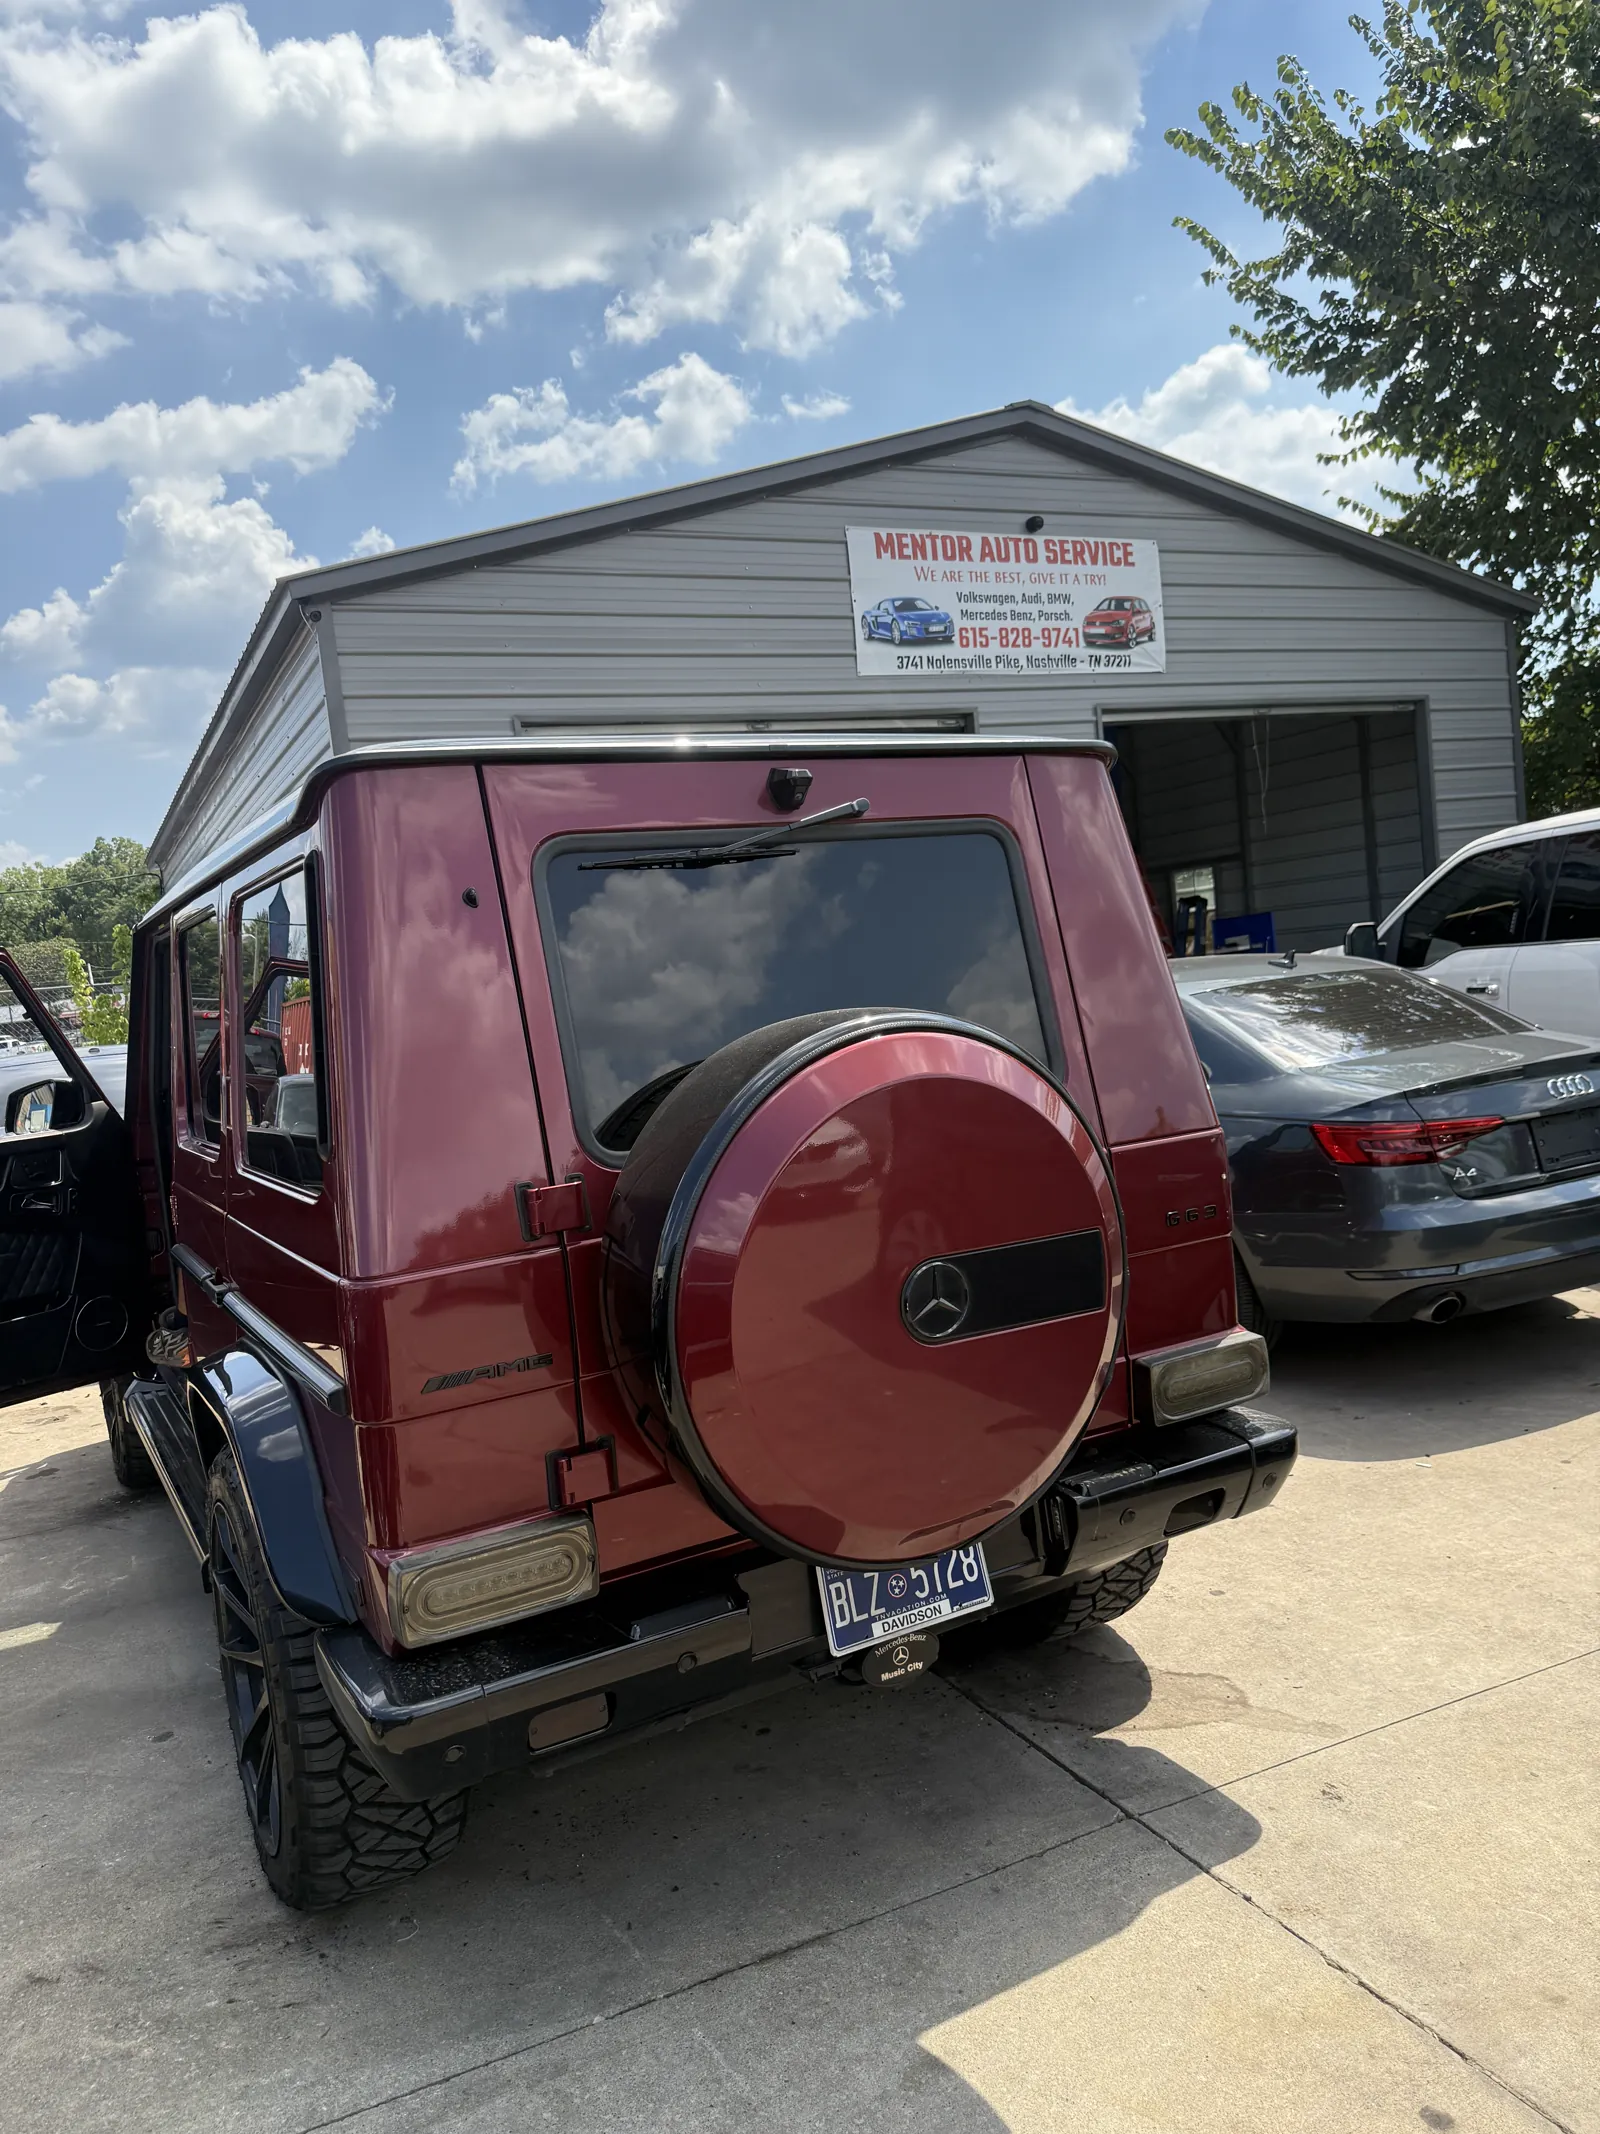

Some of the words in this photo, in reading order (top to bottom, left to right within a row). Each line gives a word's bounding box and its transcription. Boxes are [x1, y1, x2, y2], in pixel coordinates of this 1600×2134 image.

[873, 531, 975, 562] MENTOR
[979, 536, 1039, 564] AUTO
[1043, 538, 1136, 568] SERVICE
[941, 570, 964, 583] ARE
[968, 570, 990, 583] THE
[995, 571, 1026, 586] BEST,
[1029, 572, 1056, 585] GIVE
[1060, 573, 1070, 585] IT
[1072, 573, 1081, 585] A
[956, 591, 1019, 606] Volkswagen,
[1021, 592, 1045, 606] Audi,
[1047, 593, 1075, 606] BMW,
[960, 609, 1008, 621] Mercedes
[1010, 609, 1036, 623] Benz,
[1038, 609, 1073, 622] Porsch.
[958, 626, 1080, 649] 615-828-9741
[896, 655, 924, 670] 3741
[926, 654, 992, 670] Nolensville
[995, 654, 1024, 671] Pike,
[1026, 654, 1077, 669] Nashville
[1088, 654, 1102, 668] TN
[1103, 654, 1132, 668] 37211
[1453, 1166, 1478, 1181] A4
[464, 1352, 553, 1385] AMG
[829, 1572, 886, 1629] BLZ
[881, 1604, 942, 1633] DAVIDSON
[874, 1633, 927, 1658] Mercedes-Benz
[880, 1668, 906, 1682] Music
[907, 1661, 924, 1672] City
